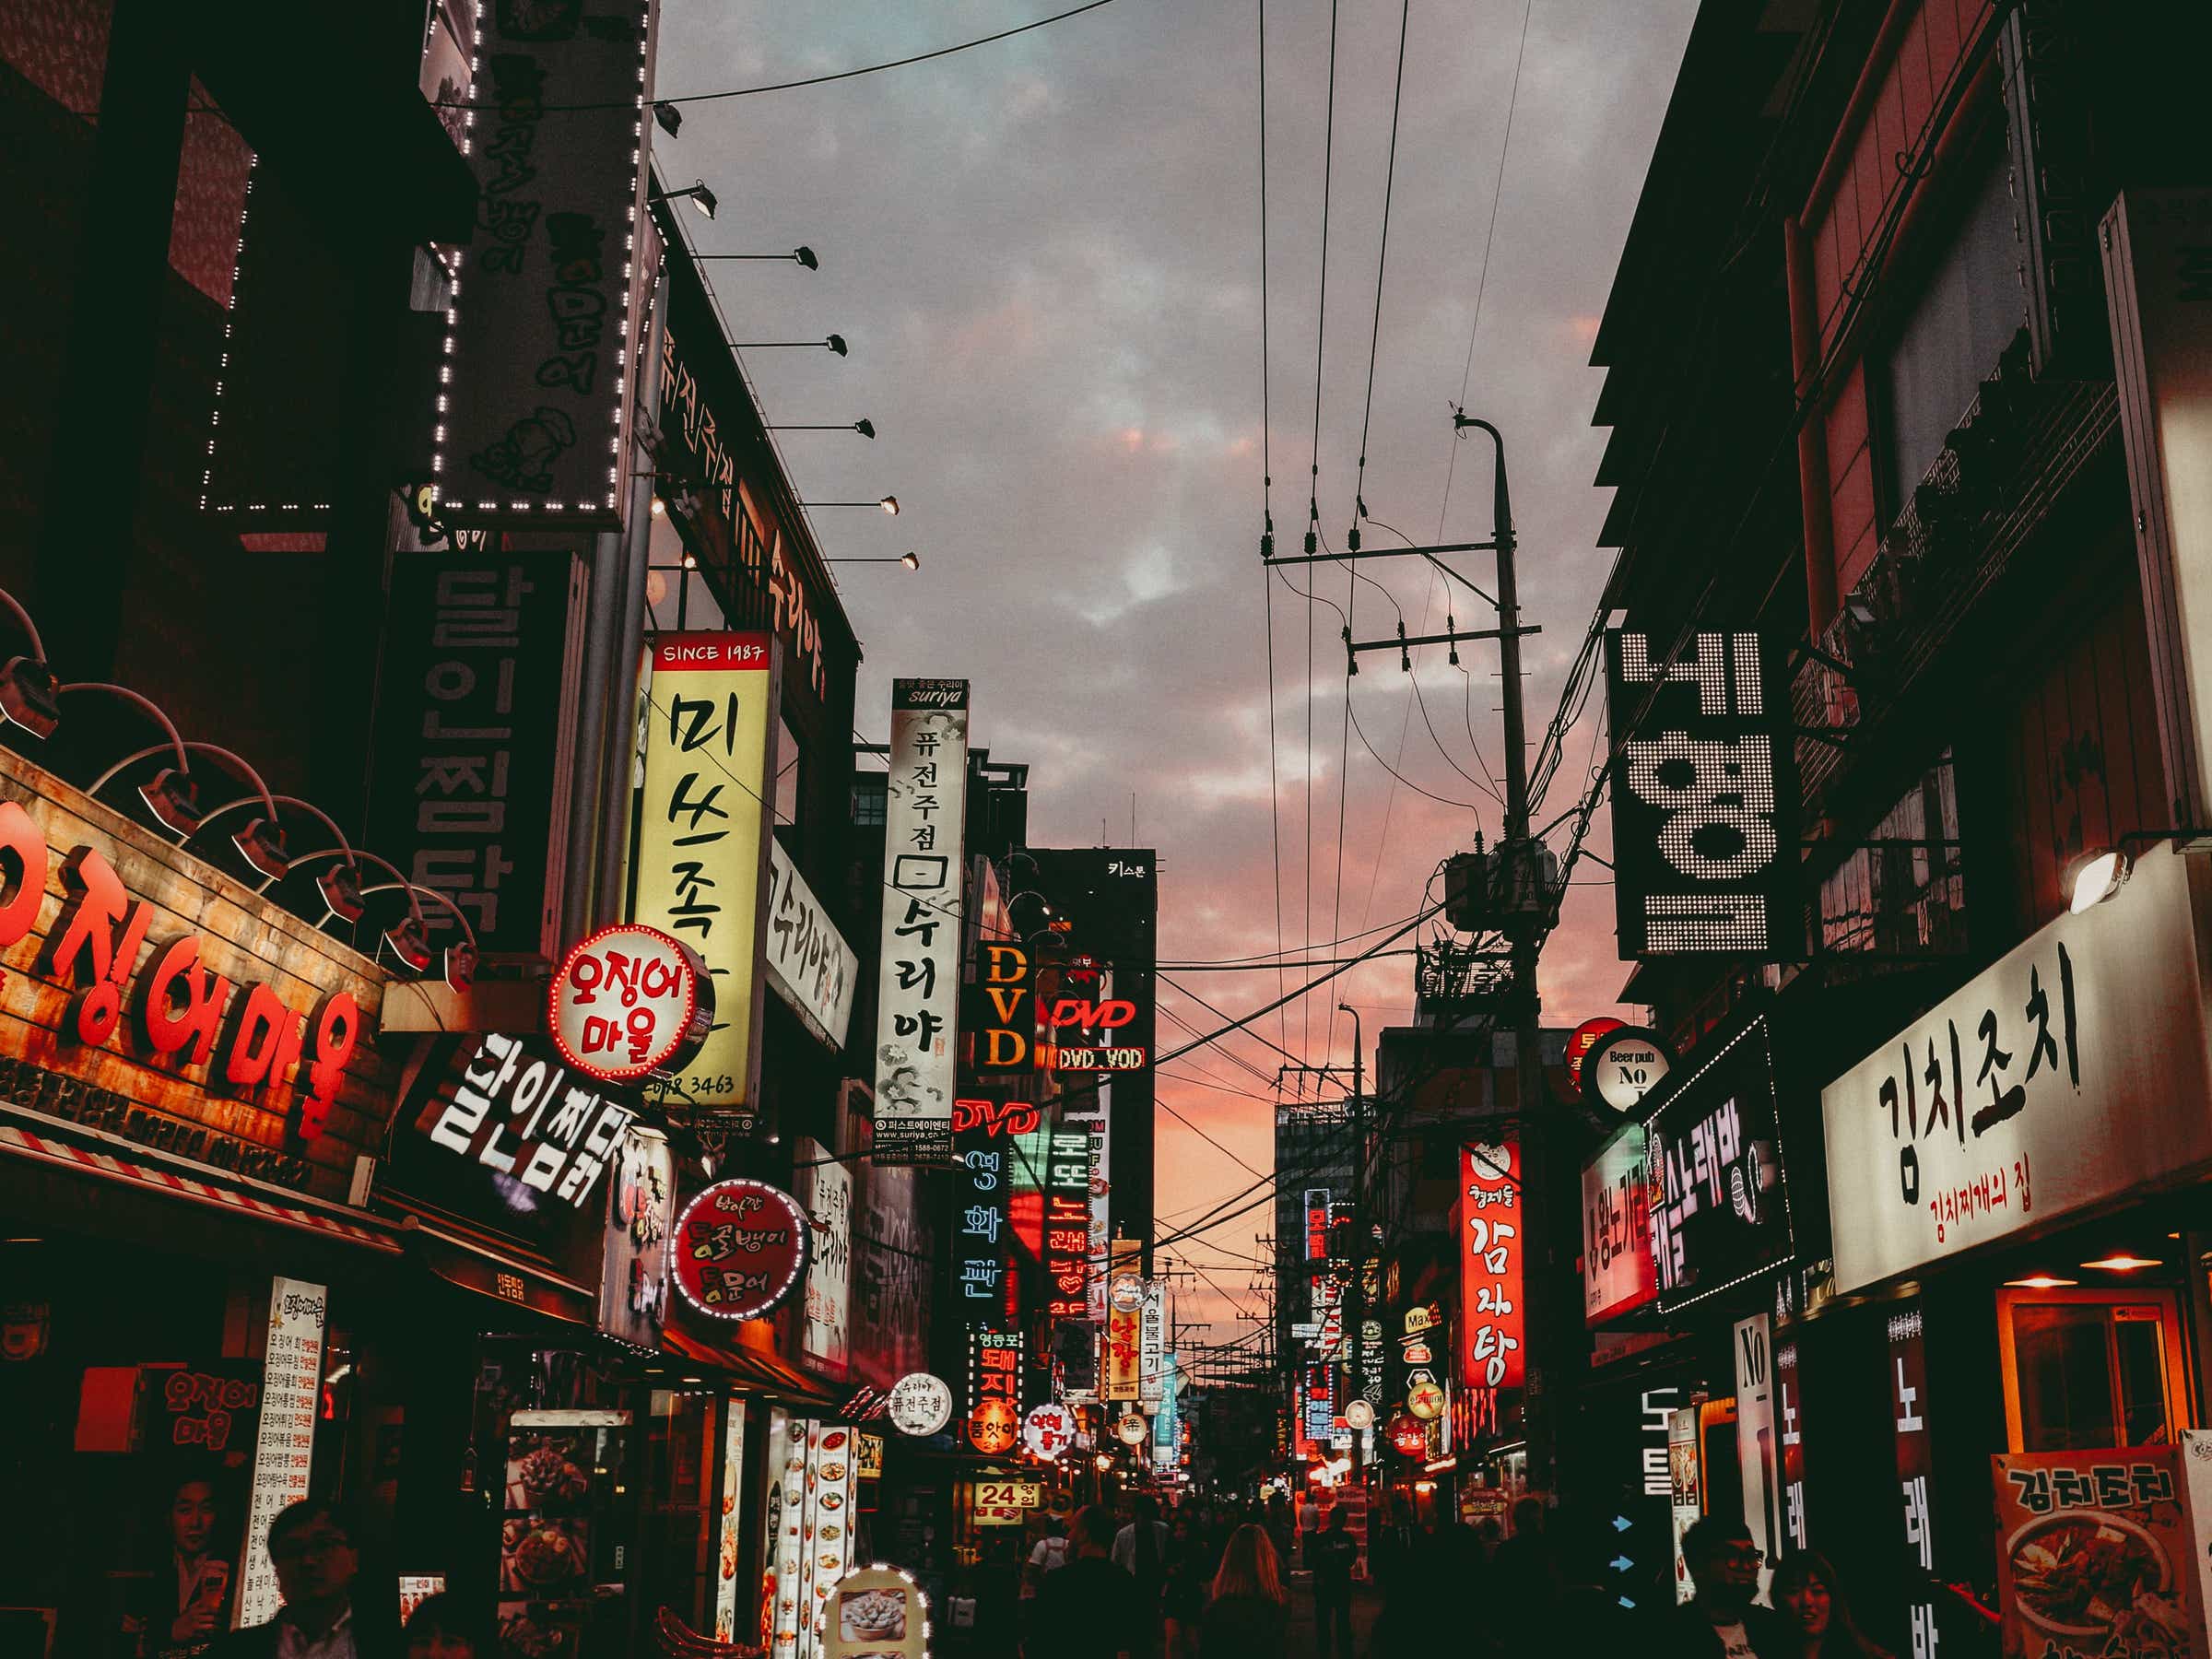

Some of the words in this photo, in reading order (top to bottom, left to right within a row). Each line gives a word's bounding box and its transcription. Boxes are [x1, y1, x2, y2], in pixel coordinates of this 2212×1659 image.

[663, 645, 721, 661] SINCE
[726, 644, 766, 662] 1987
[908, 688, 963, 708] suriya
[910, 732, 940, 851] 퓨전주점
[569, 949, 683, 1007] 오징어
[894, 899, 943, 1053] 수리야
[984, 945, 1029, 1067] DVD
[1050, 998, 1137, 1030] DVD
[1610, 1052, 1634, 1063] Beer
[1635, 1052, 1654, 1065] pub
[1880, 942, 2083, 1206] 김치조치
[691, 1074, 744, 1096] 3463
[953, 1099, 1040, 1137] DVD
[1468, 1184, 1514, 1208] 형제들
[1929, 1167, 2008, 1244] 김치찌개의
[1469, 1218, 1519, 1387] 감자탕
[166, 1371, 257, 1412] 오징어
[893, 1395, 941, 1413] 퓨전주점
[982, 1485, 1016, 1505] 24
